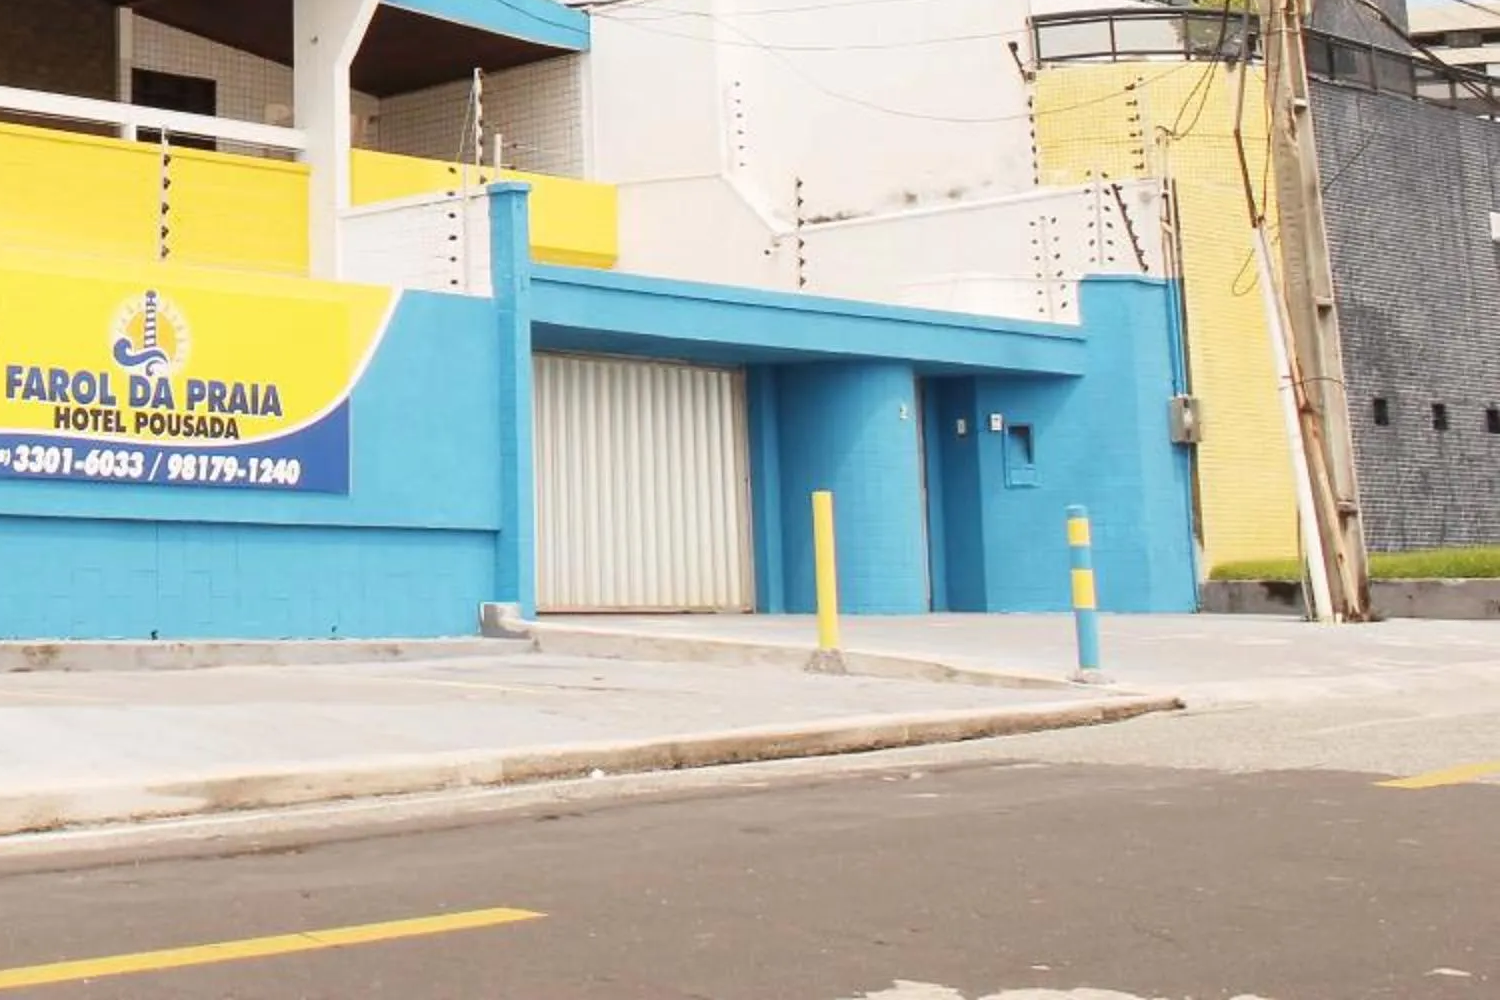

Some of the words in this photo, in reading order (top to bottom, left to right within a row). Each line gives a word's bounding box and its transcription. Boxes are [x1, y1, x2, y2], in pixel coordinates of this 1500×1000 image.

[5, 364, 117, 406] FAROL
[129, 374, 175, 411] DA
[186, 378, 283, 417] PRAIA
[54, 406, 127, 434] HOTEL
[134, 411, 240, 440] POUSADA
[12, 443, 145, 479] 3301-6033
[167, 453, 301, 485] 98179-1240
